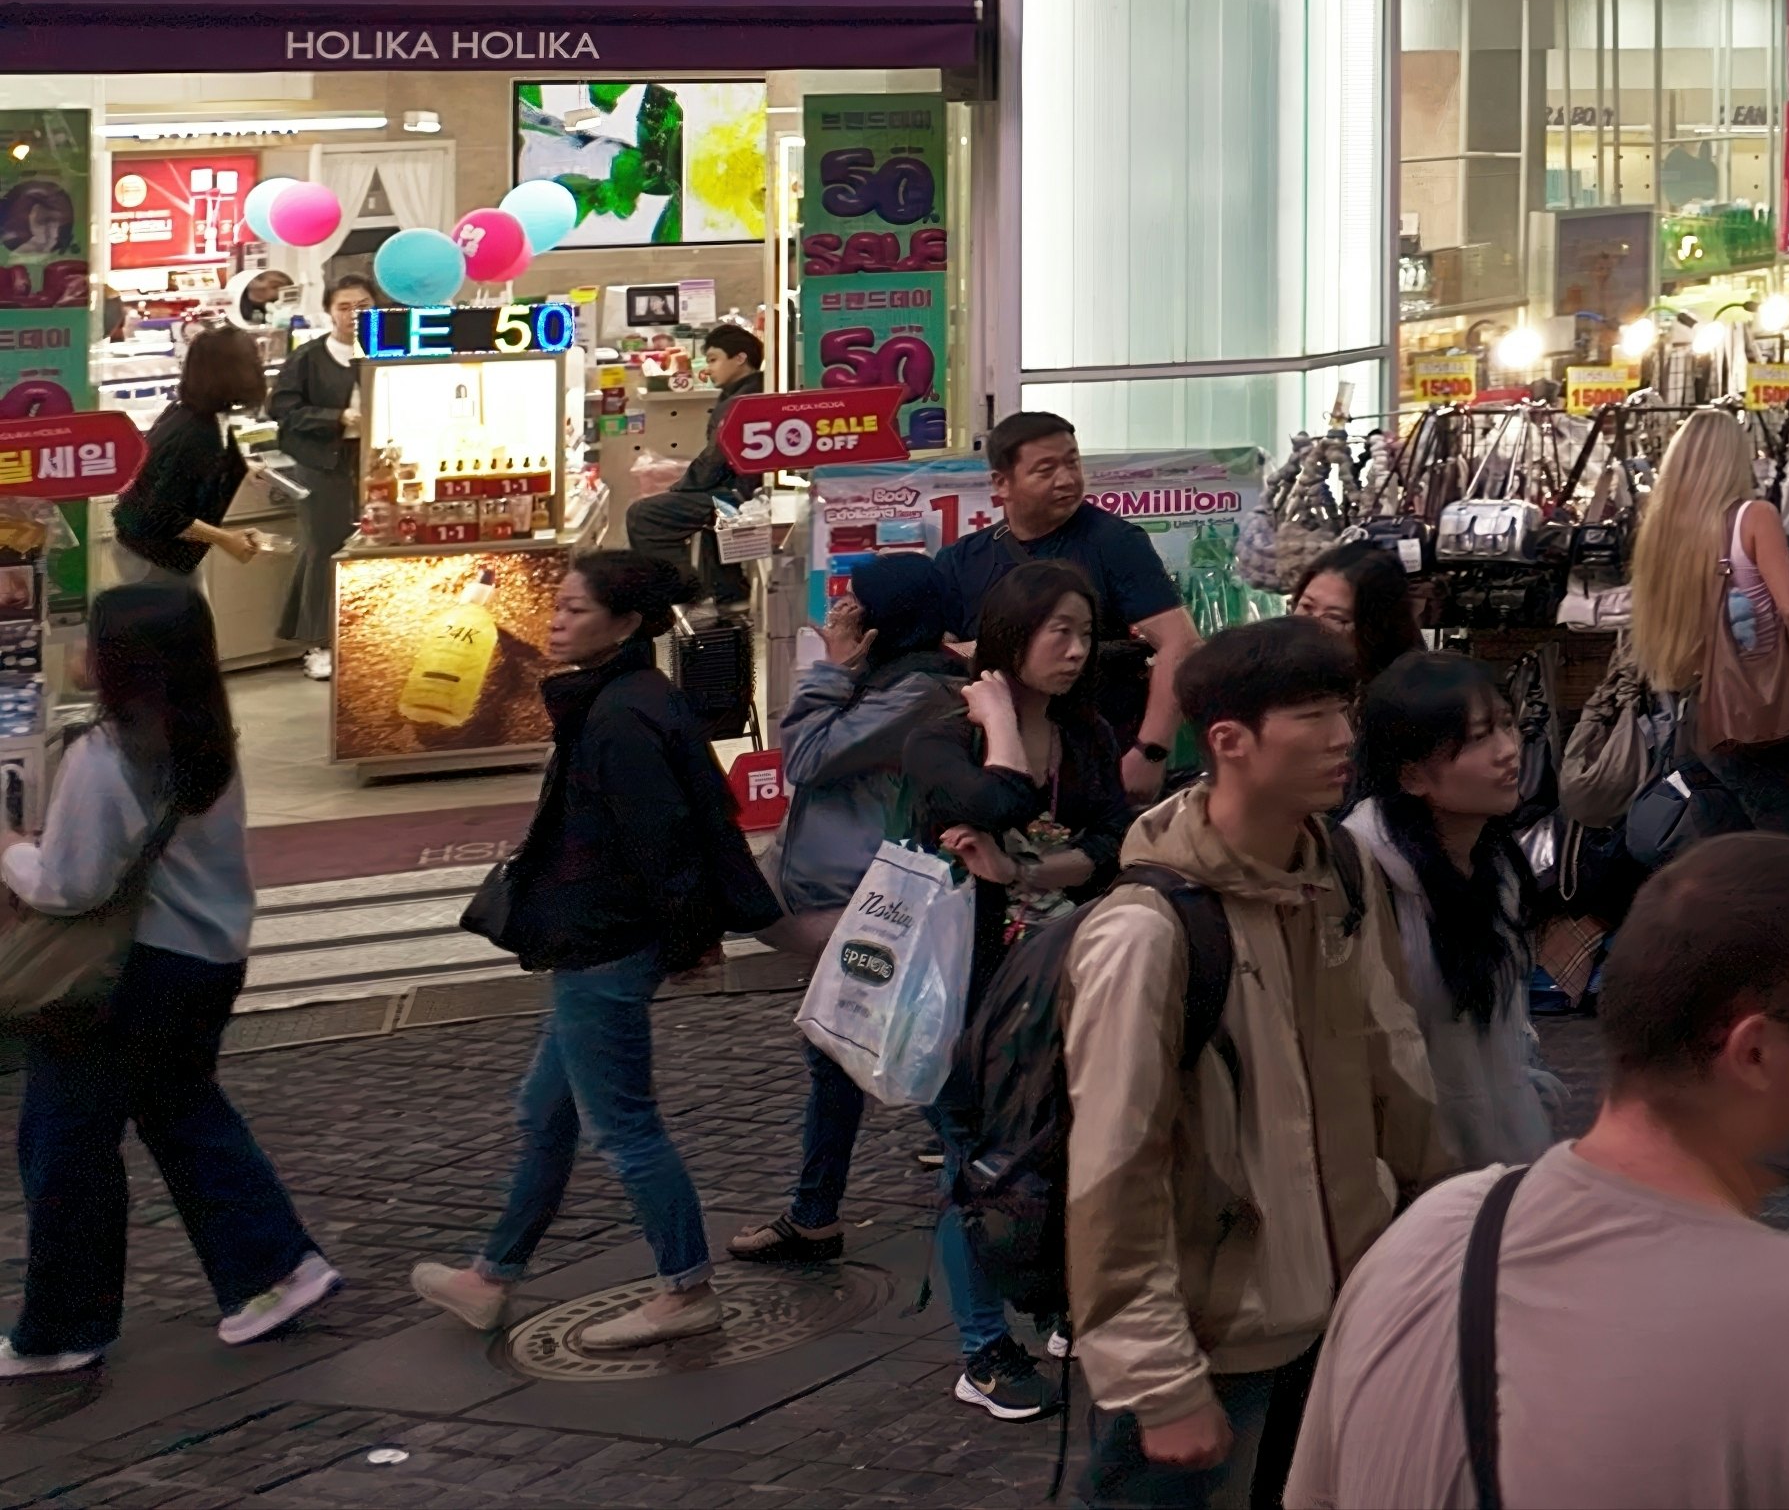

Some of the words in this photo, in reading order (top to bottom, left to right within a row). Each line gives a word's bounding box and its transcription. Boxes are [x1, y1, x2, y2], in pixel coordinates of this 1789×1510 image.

[286, 30, 440, 61] HOLIKA
[452, 30, 600, 61] HOLIKA
[803, 228, 948, 276] SALE
[494, 304, 574, 354] 50
[815, 414, 878, 436] SALE
[815, 434, 859, 452] OFF
[872, 486, 921, 507] Body
[929, 493, 1006, 548] 1+
[436, 623, 481, 645] 24K
